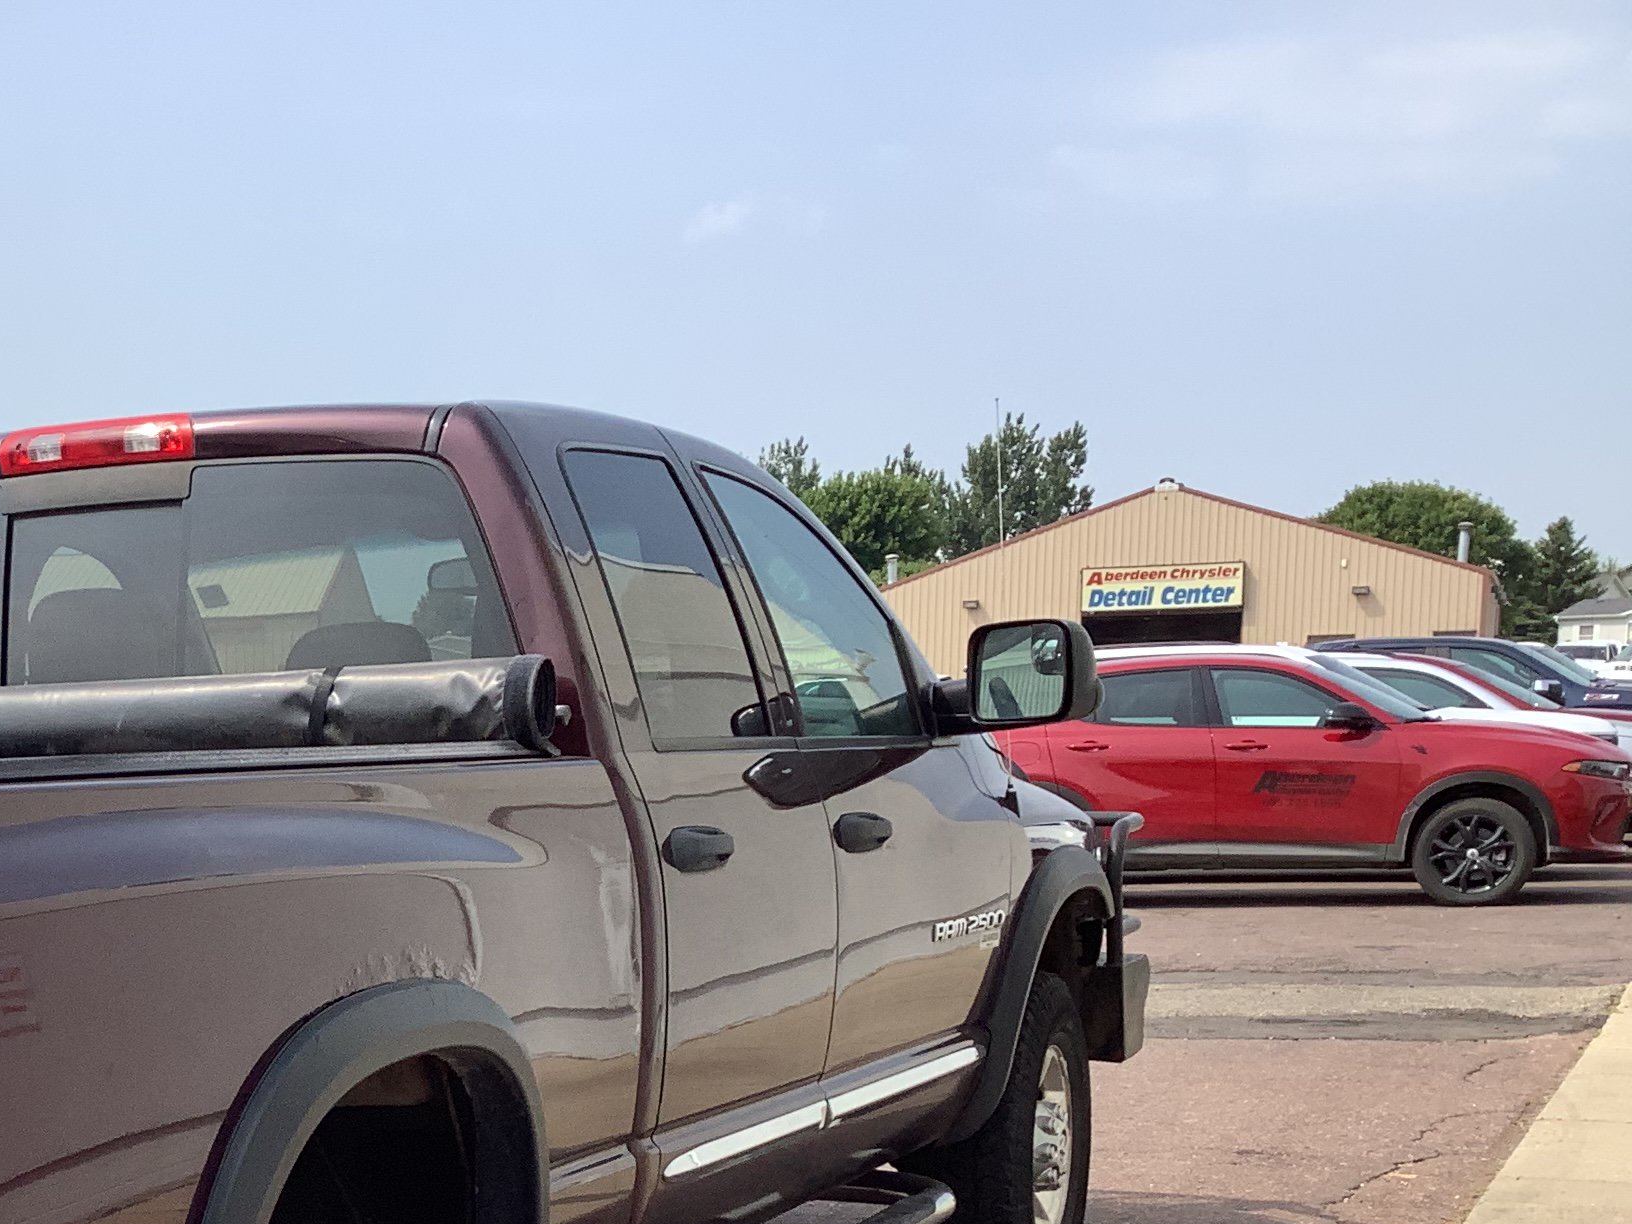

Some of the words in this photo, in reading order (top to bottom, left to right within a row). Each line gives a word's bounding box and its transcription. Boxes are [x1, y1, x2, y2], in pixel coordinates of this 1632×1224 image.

[1086, 571, 1167, 586] Aberdeen
[1170, 567, 1240, 579] Chrysler
[1088, 586, 1155, 607] Detail
[1160, 585, 1235, 605] Center
[932, 918, 968, 942] RAM
[968, 909, 1006, 930] 2500
